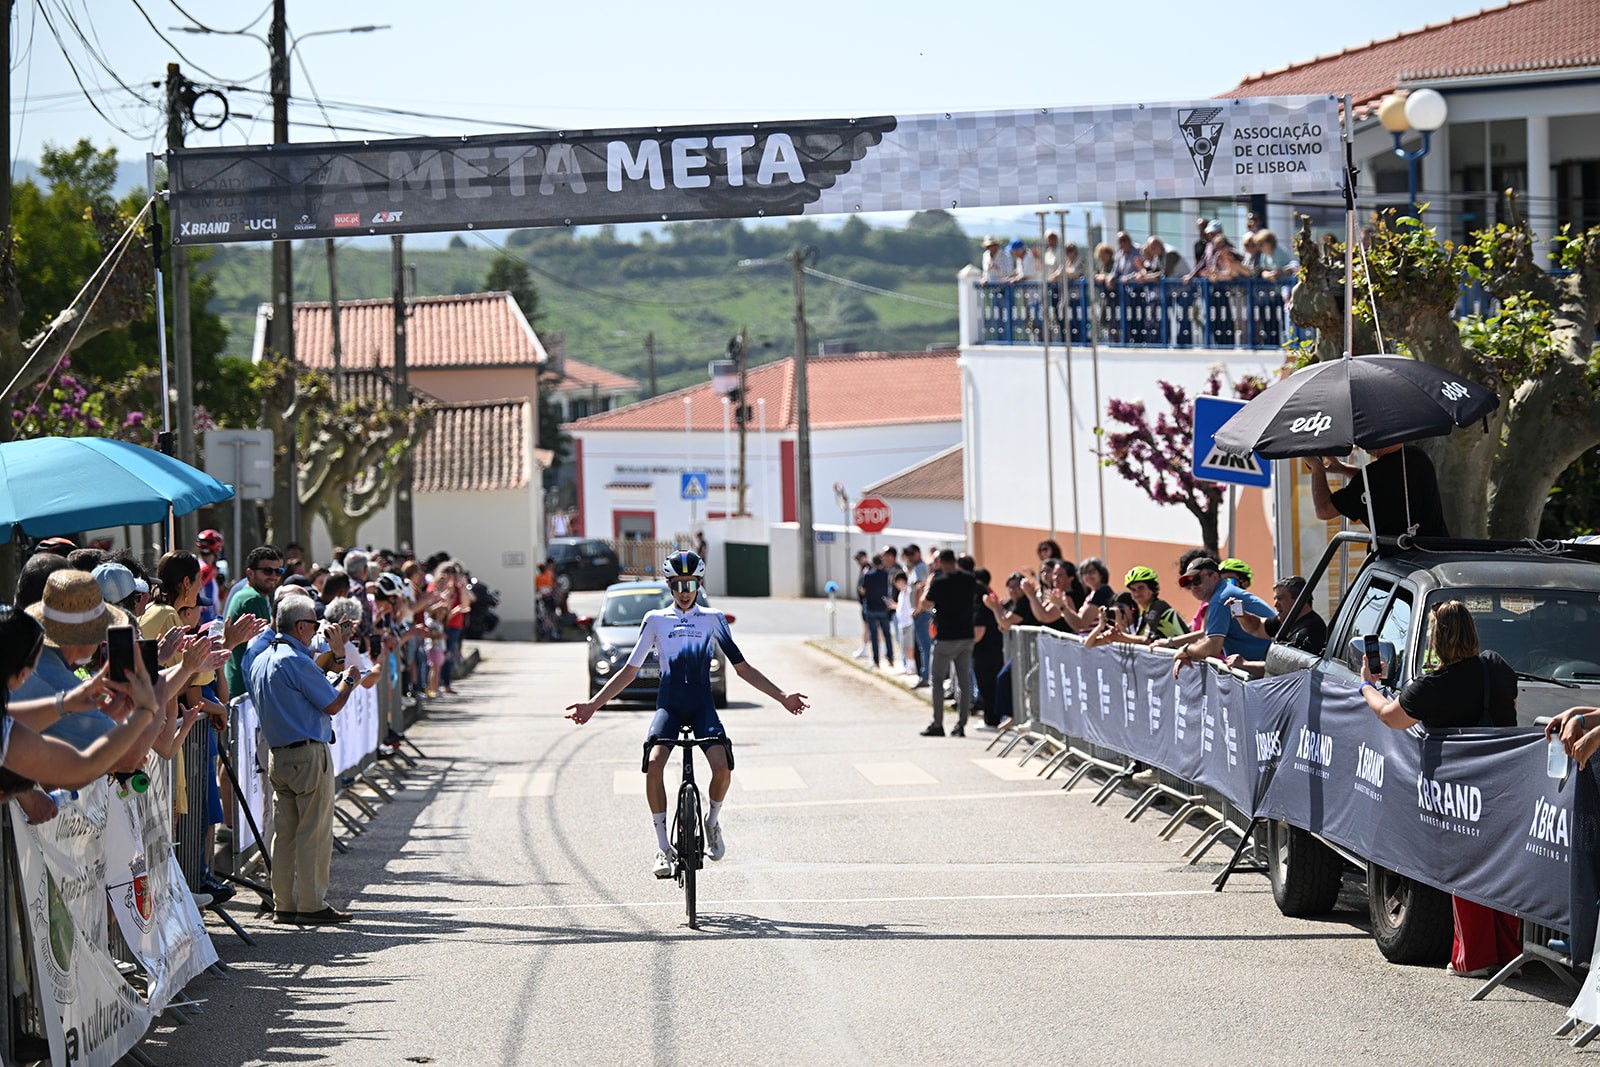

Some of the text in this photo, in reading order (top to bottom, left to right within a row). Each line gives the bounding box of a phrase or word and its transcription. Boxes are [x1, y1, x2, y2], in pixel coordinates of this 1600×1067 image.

[1233, 122, 1322, 140] ASSOCIAÇÃO
[1235, 142, 1322, 157] DE CICLISMO
[387, 143, 588, 202] META
[606, 133, 806, 193] META
[1235, 160, 1307, 175] DE LISBOA
[180, 221, 231, 236] XBRAND
[249, 218, 277, 230] UCI
[1441, 381, 1471, 401] edp
[1289, 411, 1332, 437] edp
[855, 507, 889, 524] STOP
[1295, 724, 1333, 767] XBRAND
[1355, 741, 1385, 789] XBRAND
[1416, 770, 1482, 823] XBRAND
[1420, 813, 1480, 838] MARKETING AGENCY
[1528, 795, 1569, 848] XBRA
[1525, 842, 1560, 861] MARKETING
